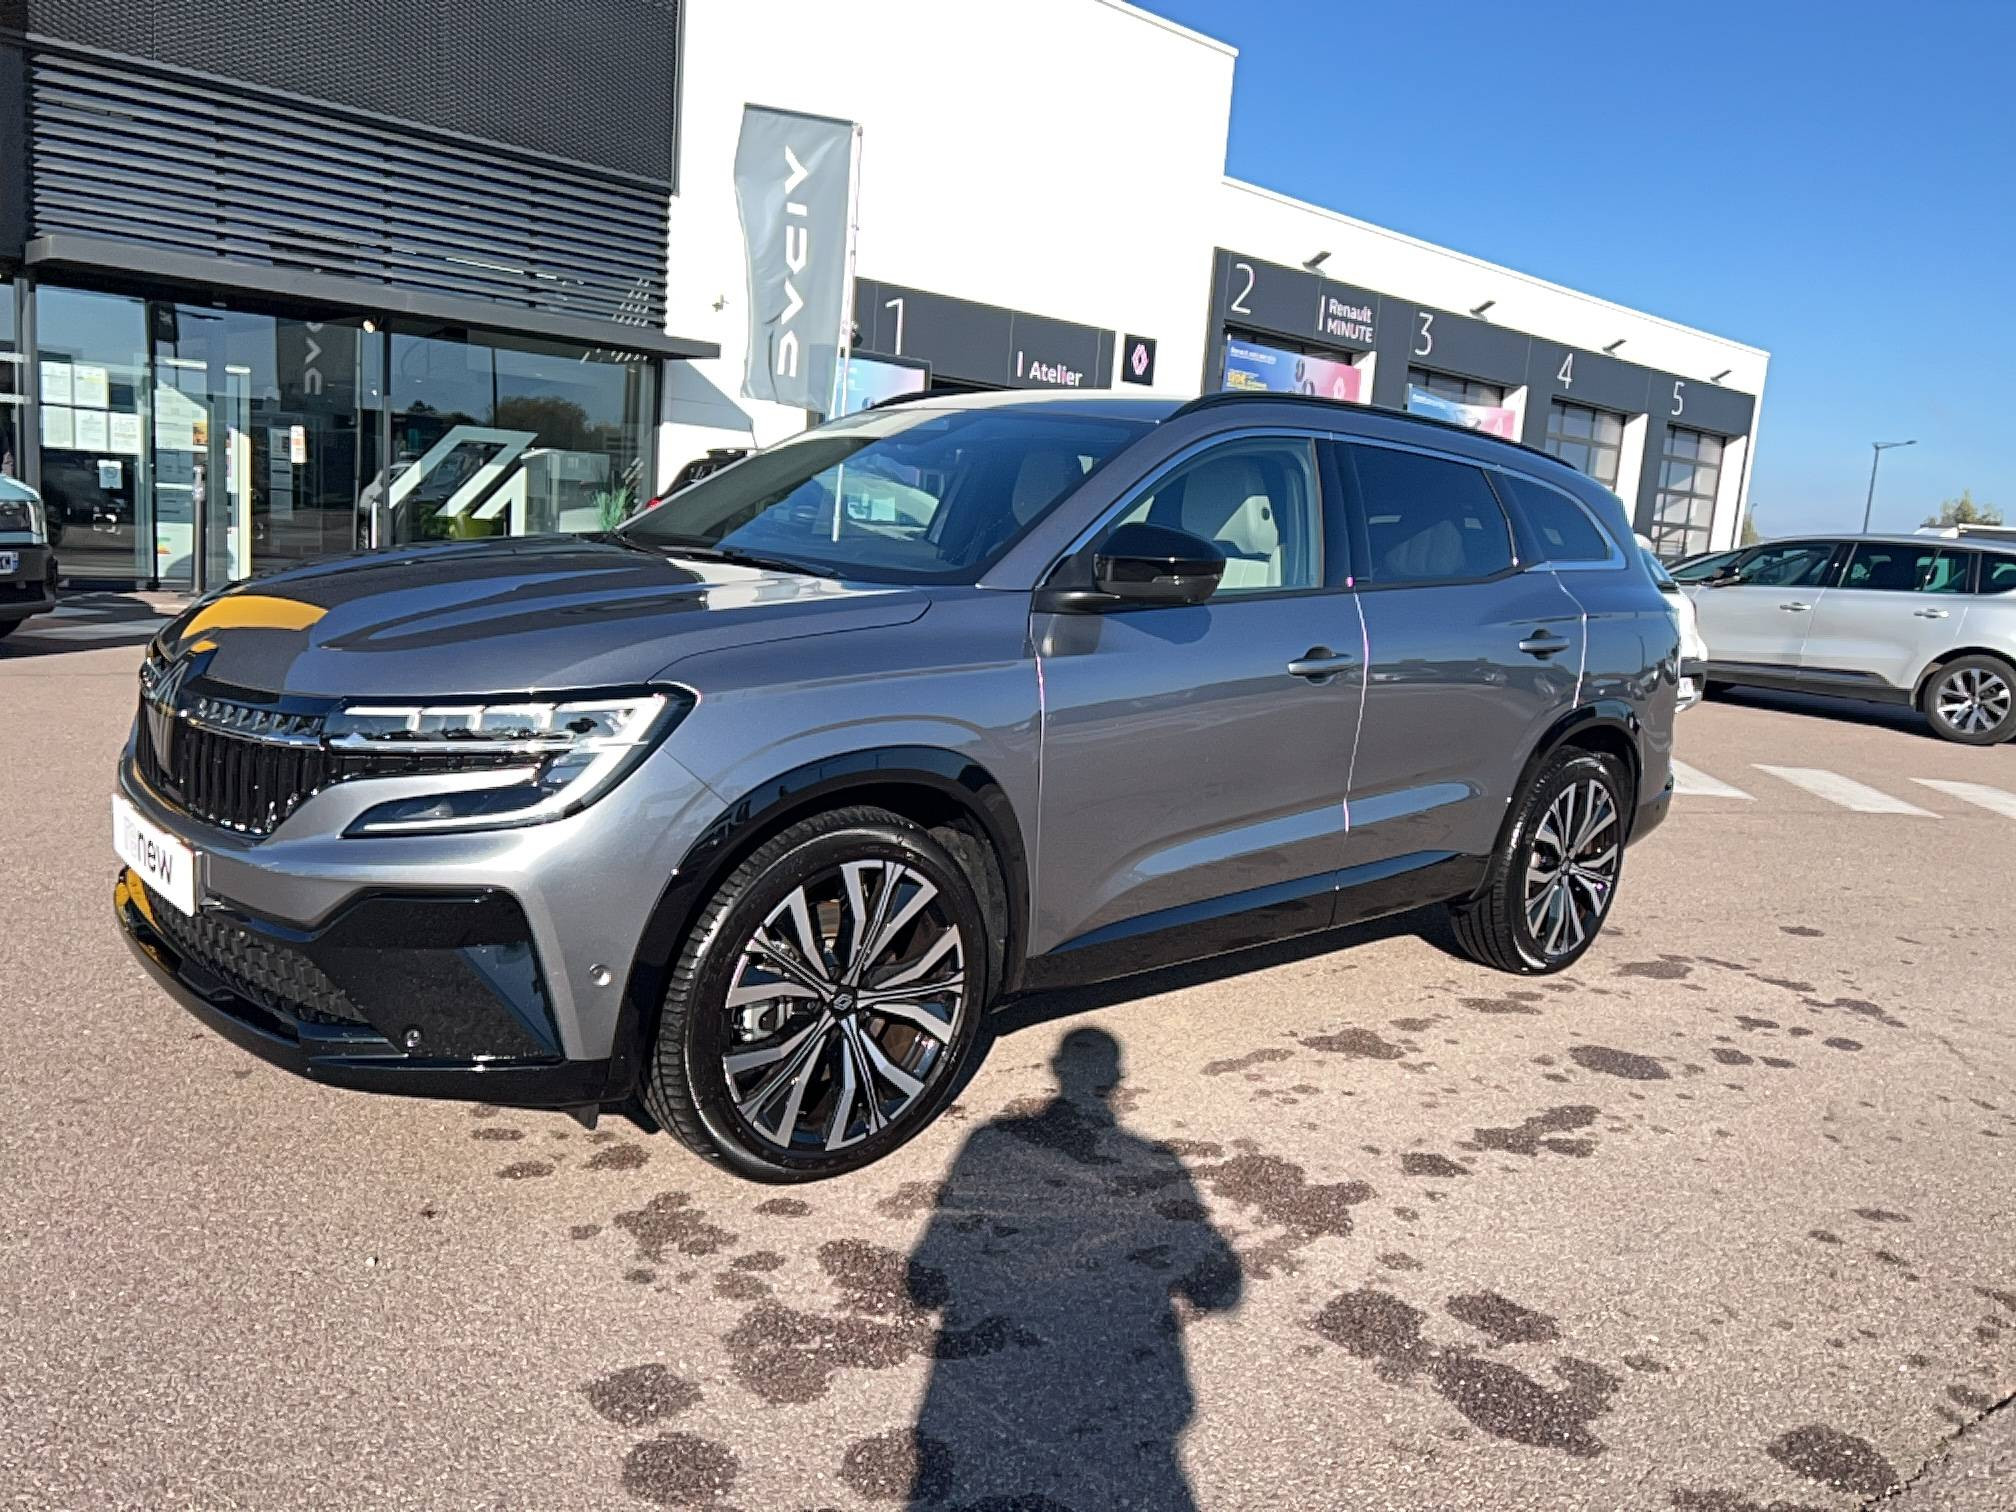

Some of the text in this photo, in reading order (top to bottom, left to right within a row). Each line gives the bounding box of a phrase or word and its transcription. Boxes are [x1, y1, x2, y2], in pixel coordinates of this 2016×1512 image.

[1230, 262, 1255, 315] 2
[885, 297, 904, 356] 1
[1329, 298, 1372, 323] Renault
[1327, 317, 1373, 343] MINUTE
[1414, 311, 1434, 356] 3
[1029, 360, 1083, 387] Atelier
[1557, 352, 1574, 390] 4
[1670, 380, 1685, 417] 5
